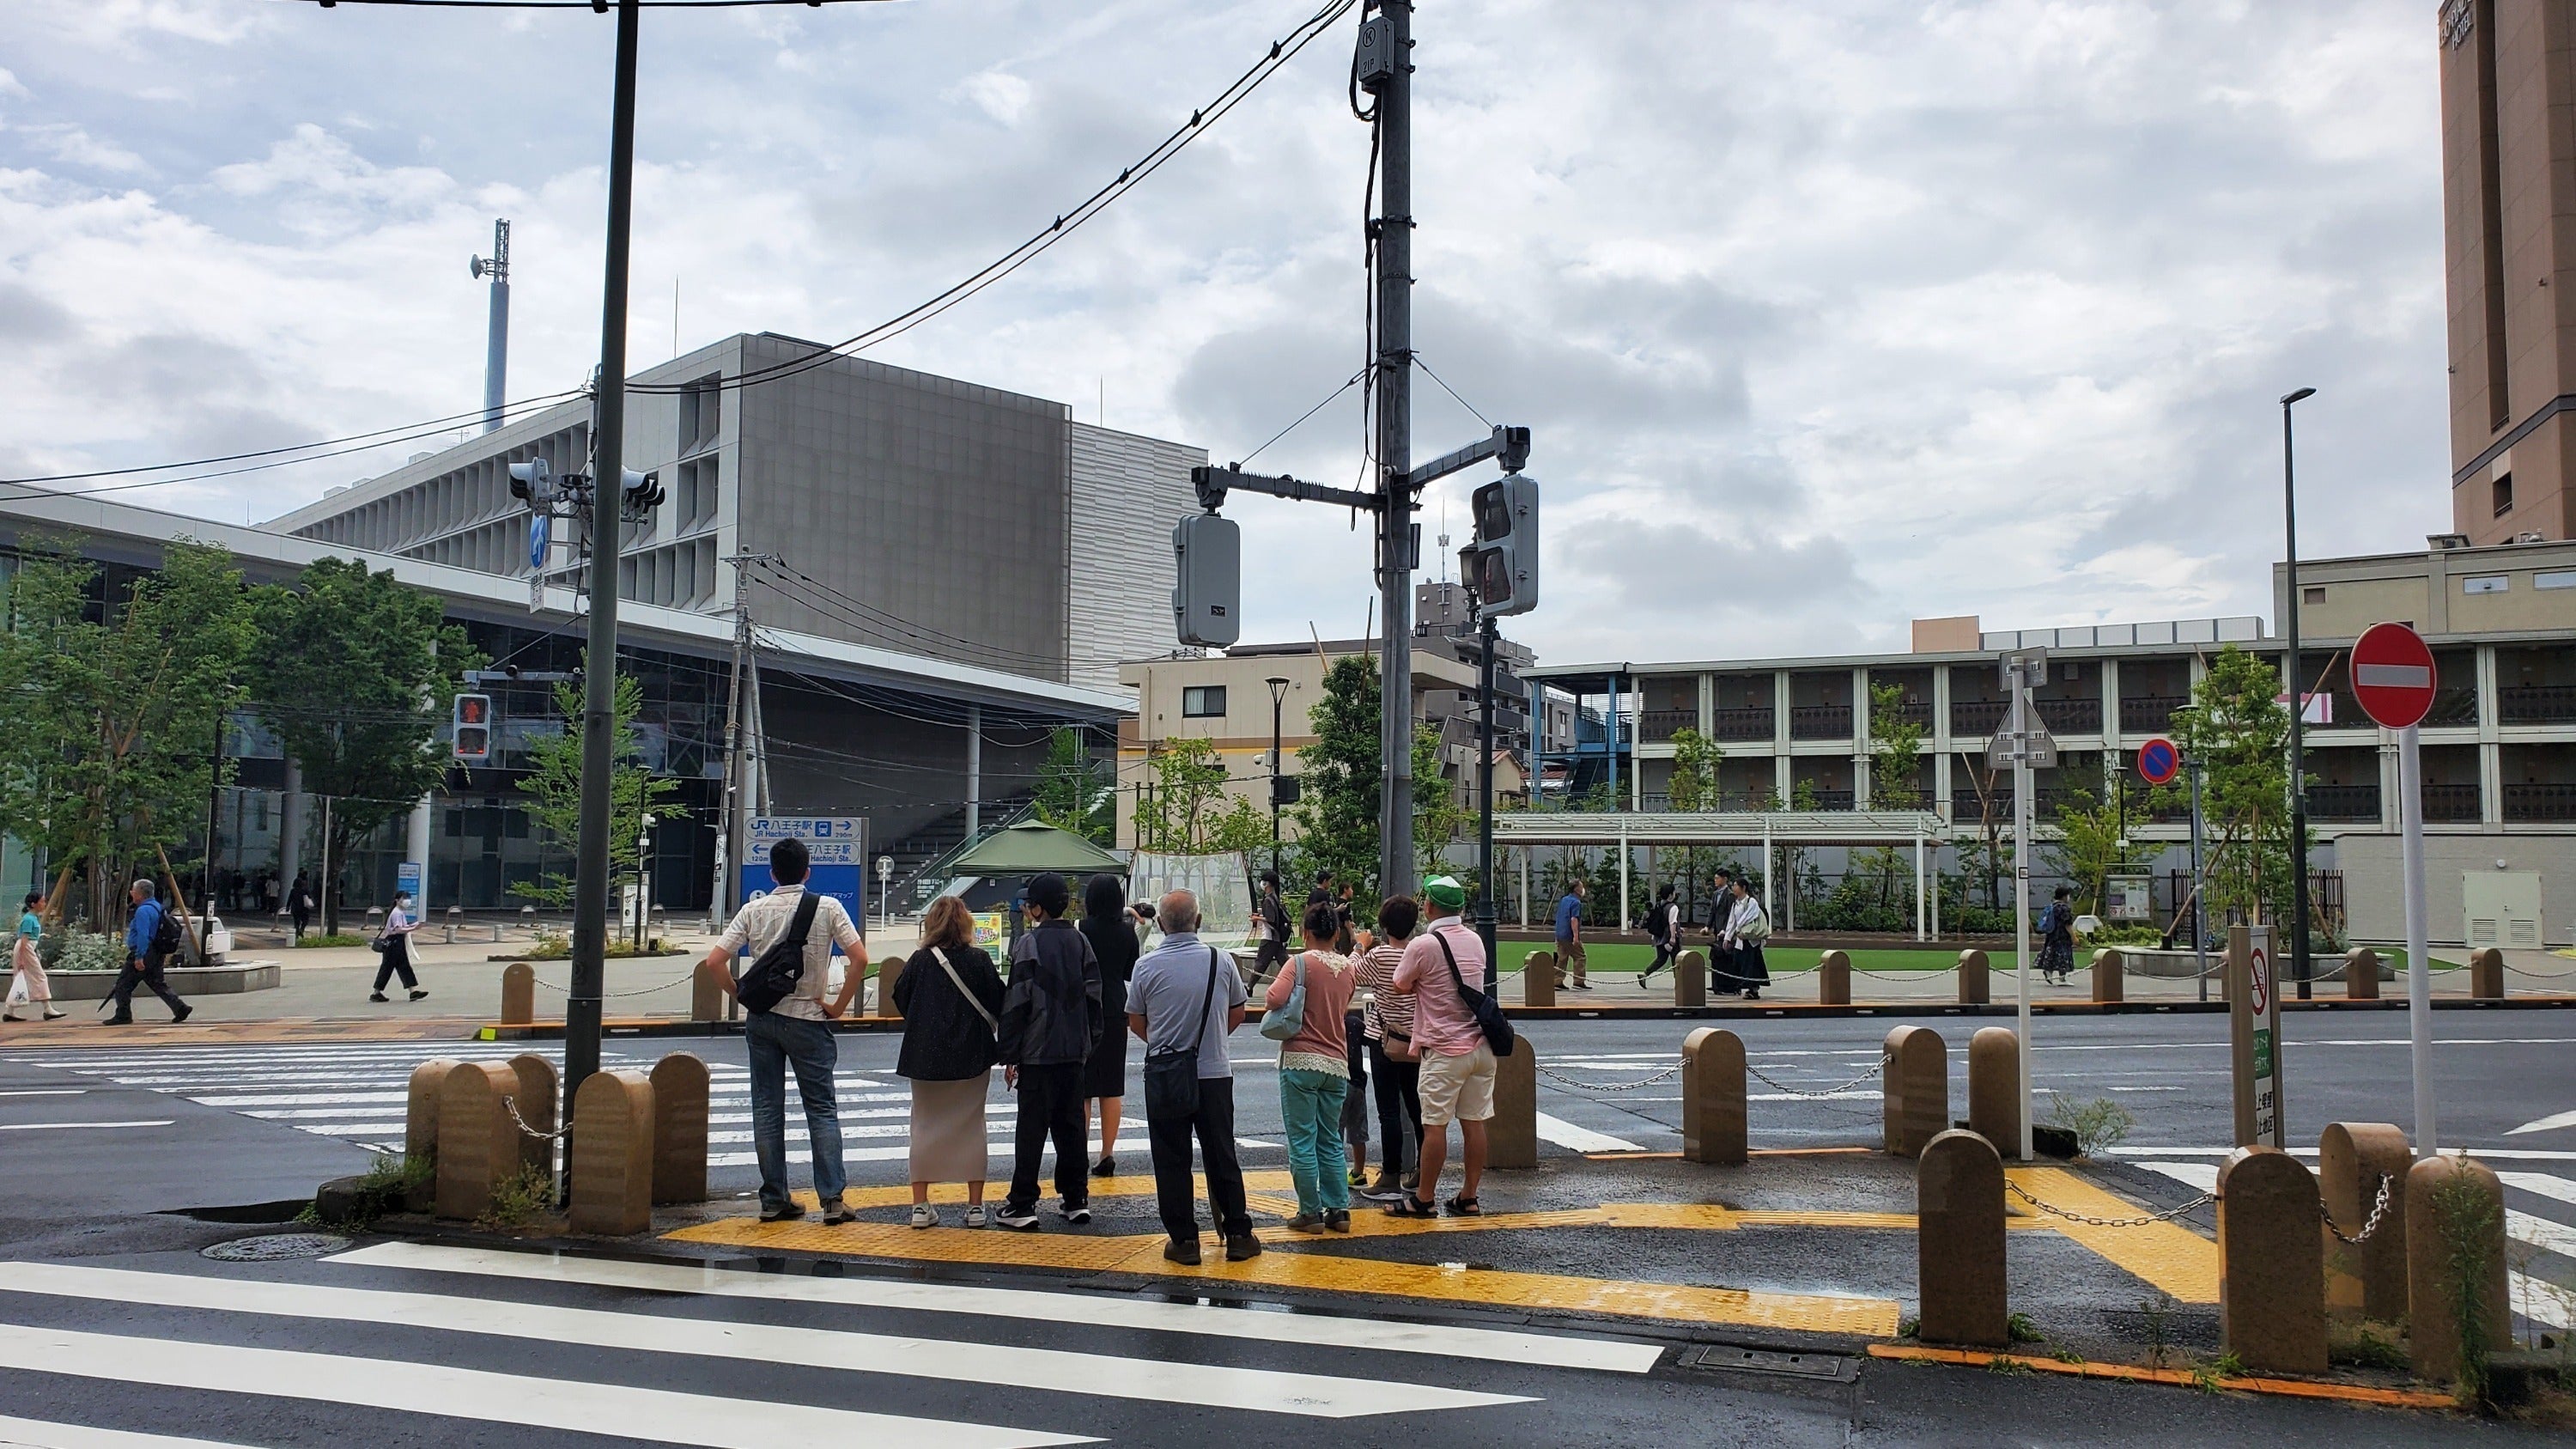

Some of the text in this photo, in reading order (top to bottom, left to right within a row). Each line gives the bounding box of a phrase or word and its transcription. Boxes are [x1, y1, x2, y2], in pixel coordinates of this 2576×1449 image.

[1364, 28, 1374, 46] K
[2451, 11, 2473, 51] HOTEL
[765, 830, 793, 838] Hachioji
[793, 830, 808, 838] Sta.
[2256, 1091, 2273, 1111] 上喫煙
[2256, 1115, 2274, 1136] 止地区
